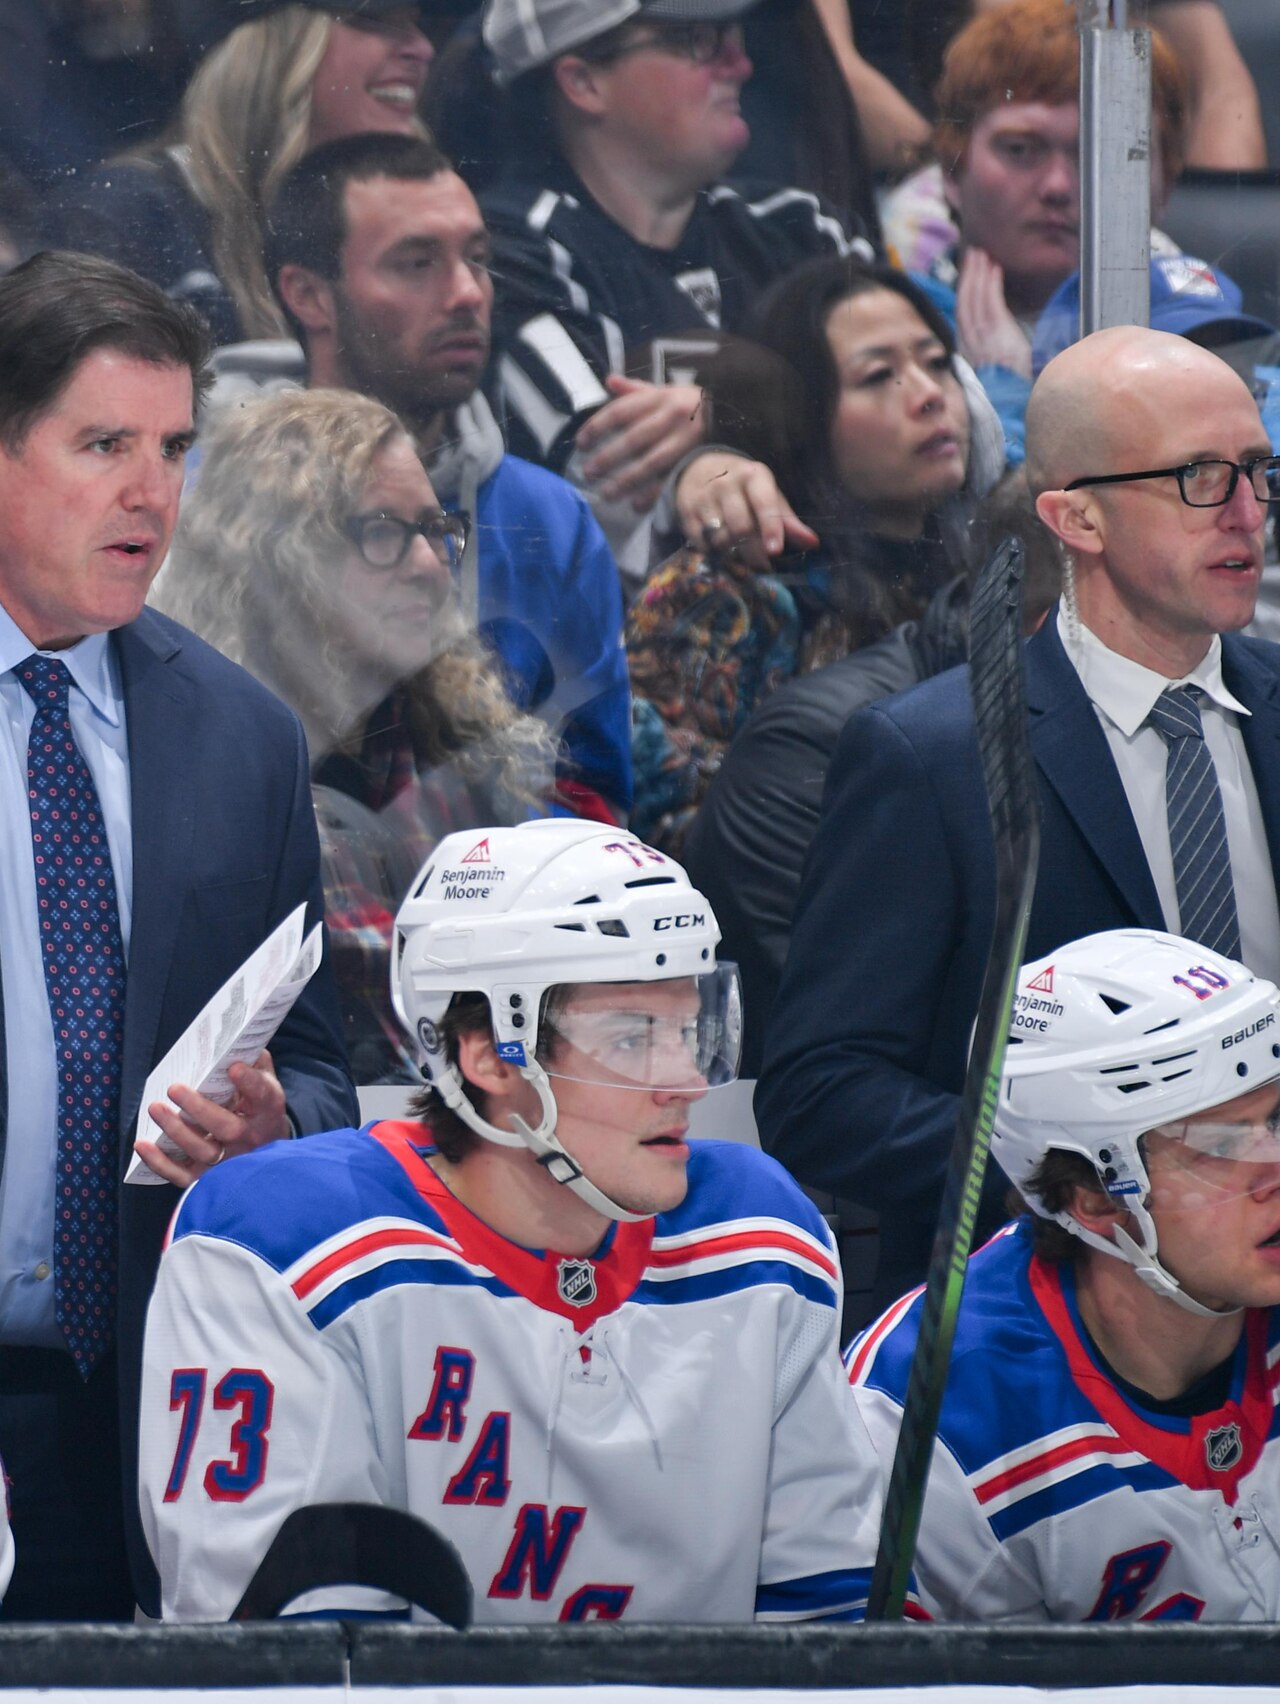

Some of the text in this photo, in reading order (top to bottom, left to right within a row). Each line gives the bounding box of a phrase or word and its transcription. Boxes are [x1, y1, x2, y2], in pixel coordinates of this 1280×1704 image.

[440, 866, 506, 885] Benjamin
[444, 885, 491, 901] Moore
[653, 914, 705, 932] CCM
[1172, 965, 1231, 1001] 10
[1012, 992, 1065, 1017] enjamin
[162, 1367, 275, 1503] 73
